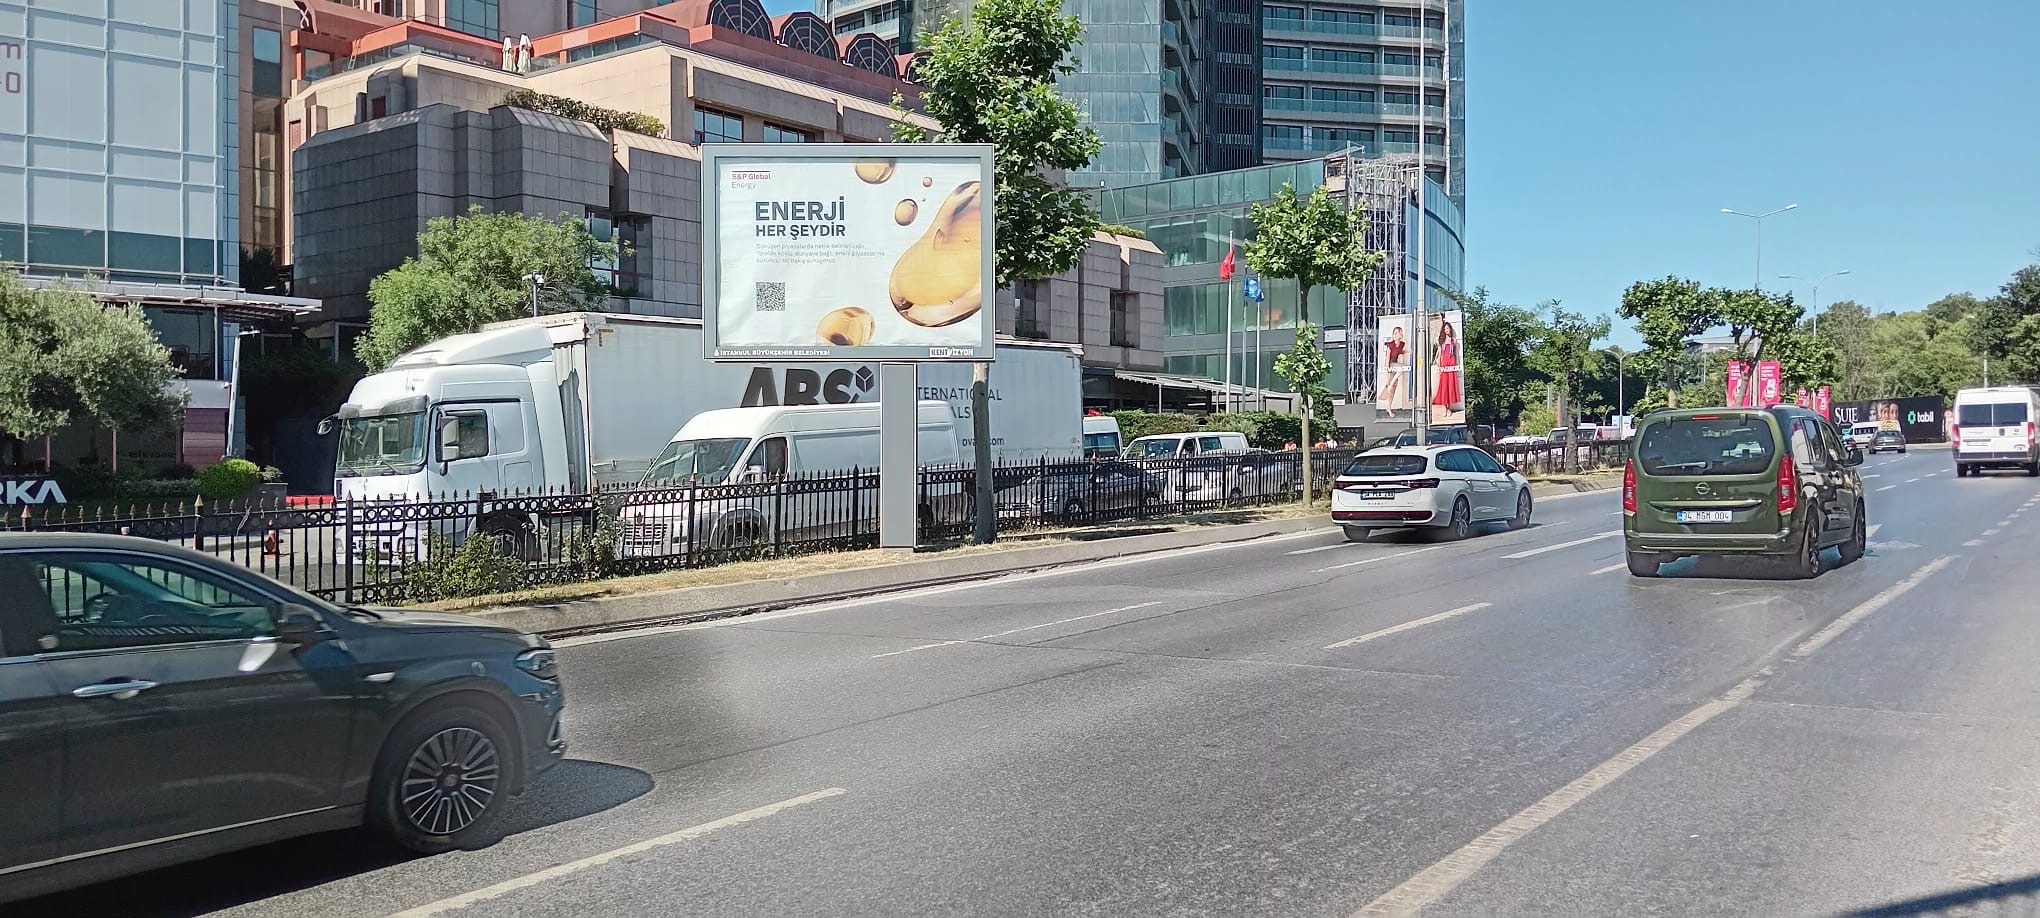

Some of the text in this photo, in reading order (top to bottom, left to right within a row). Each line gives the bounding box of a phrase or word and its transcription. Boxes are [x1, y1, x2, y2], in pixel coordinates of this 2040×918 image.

[731, 172, 771, 181] S&P Global
[731, 181, 757, 190] Energy
[755, 195, 845, 221] ENERJİ
[755, 221, 846, 241] HER ŞEYDİR
[0, 481, 67, 505] KA
